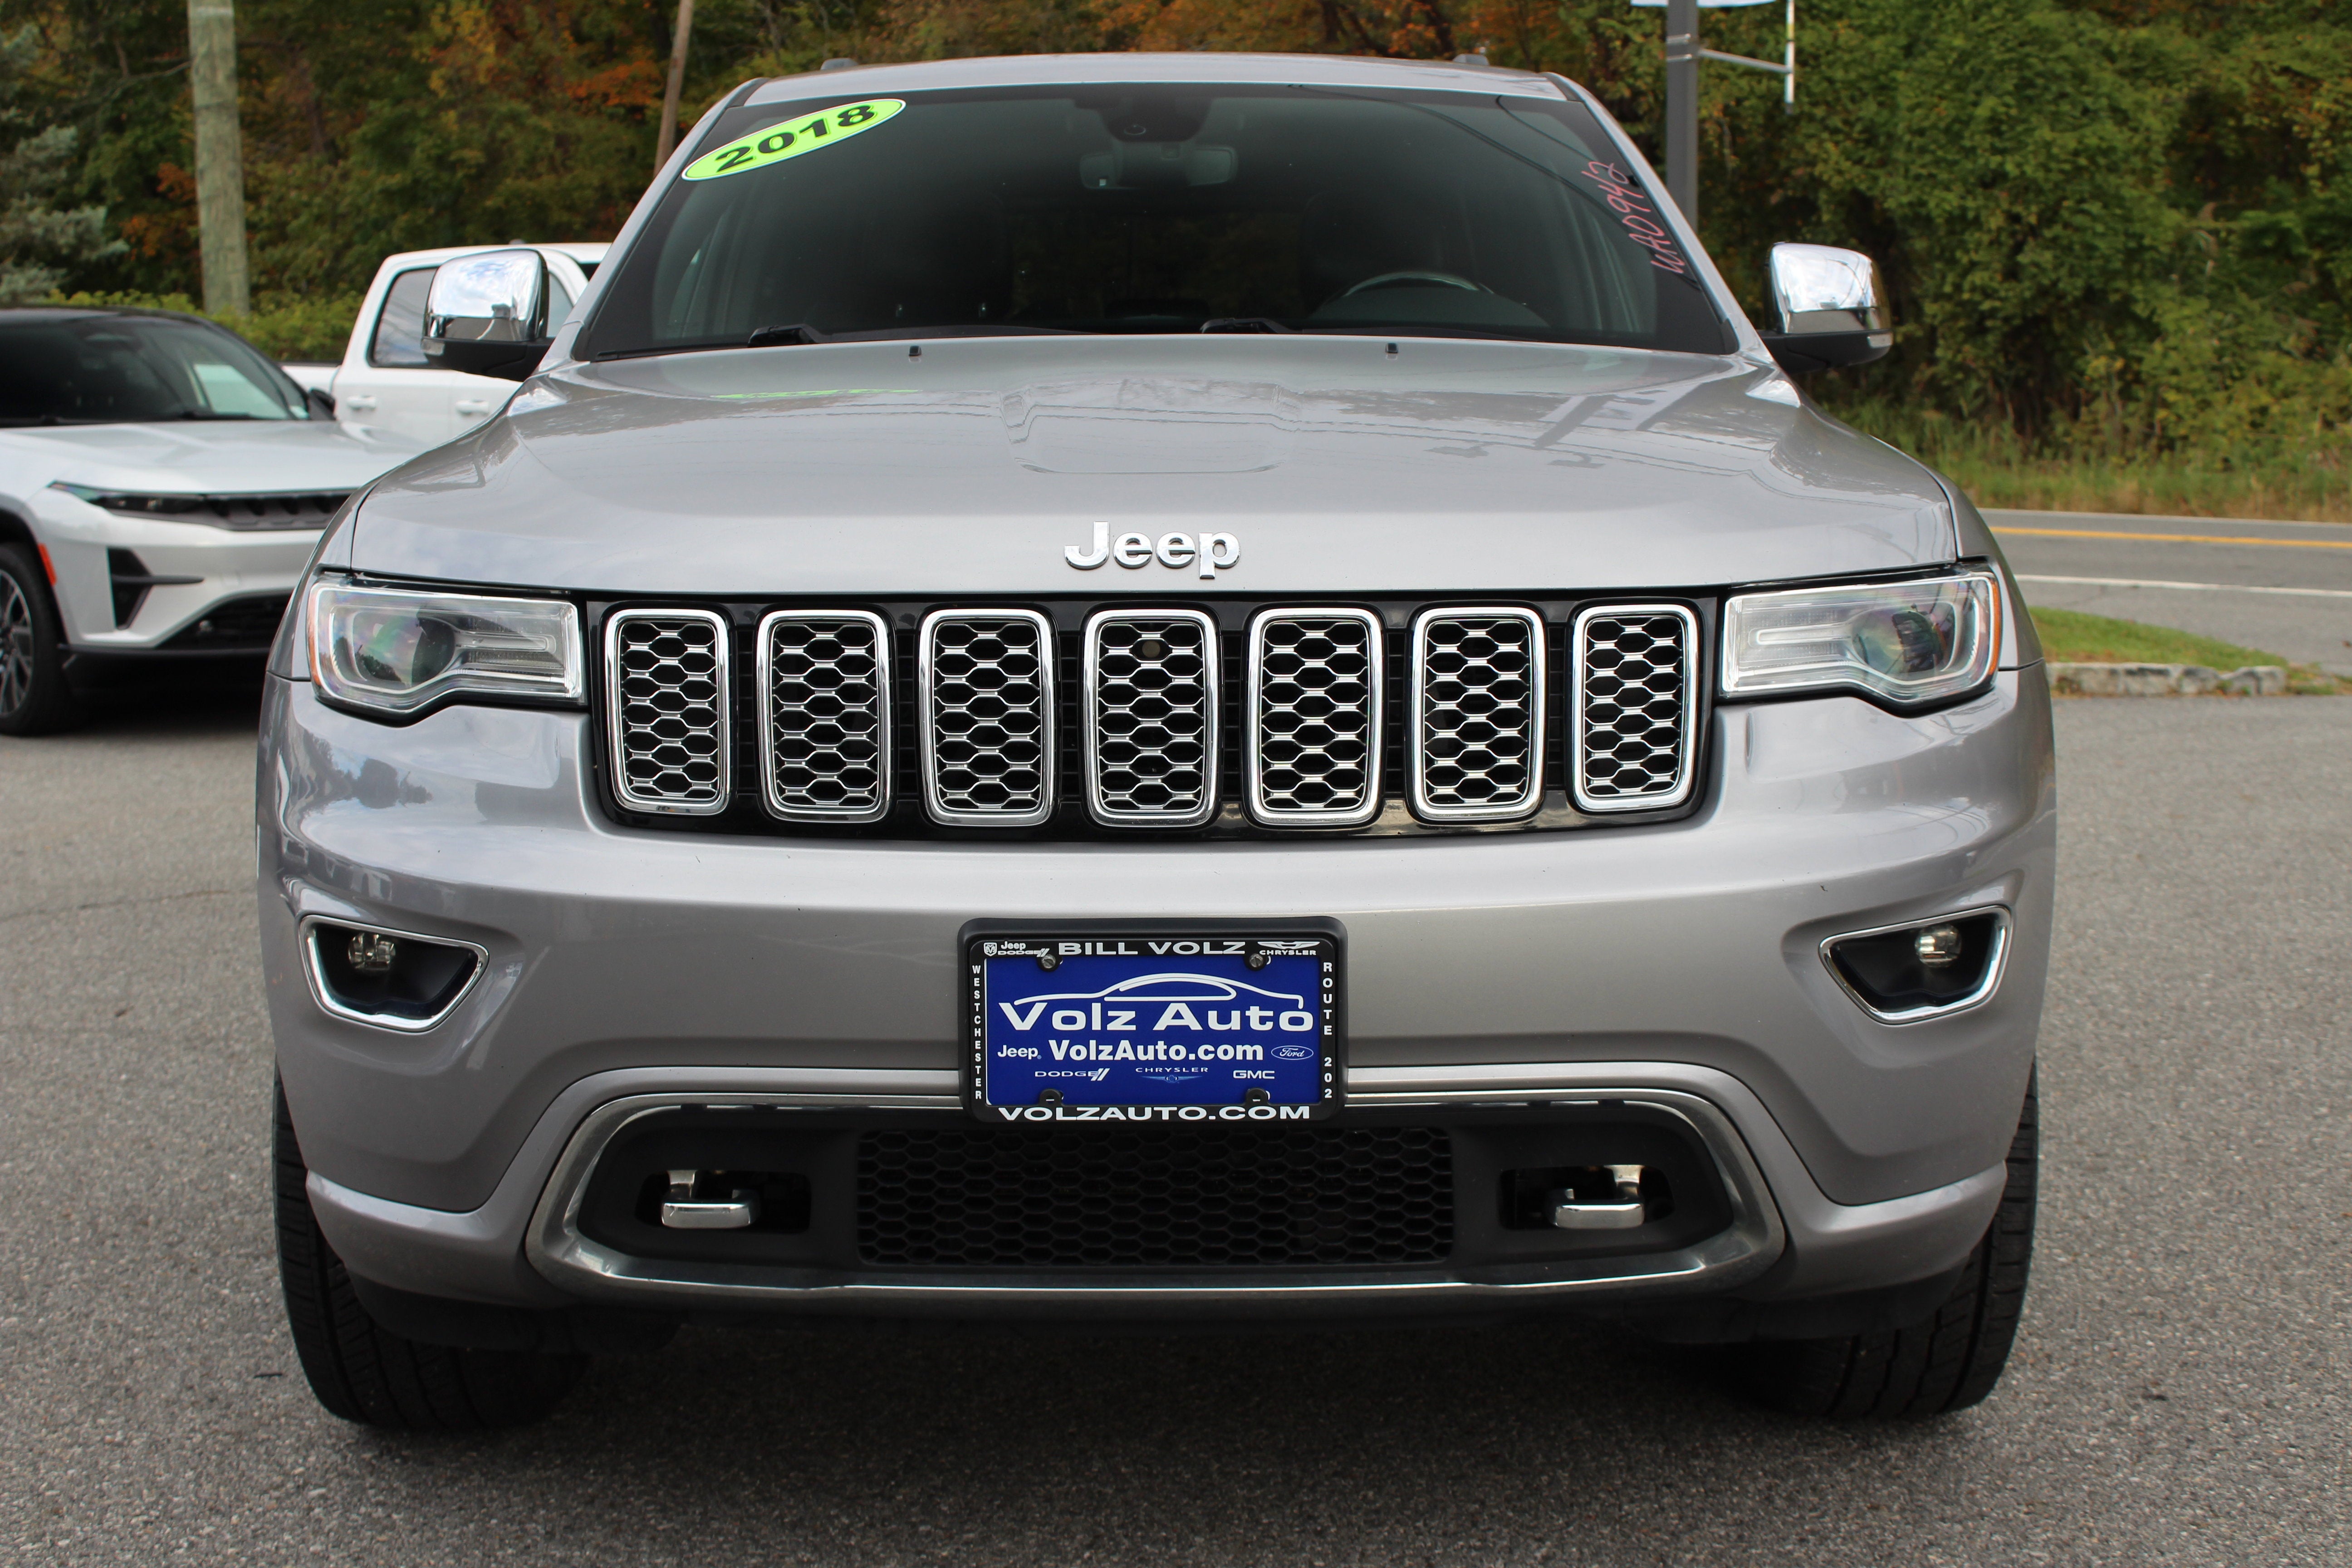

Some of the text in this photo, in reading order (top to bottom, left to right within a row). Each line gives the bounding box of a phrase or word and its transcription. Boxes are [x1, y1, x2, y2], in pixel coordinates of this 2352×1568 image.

[715, 105, 877, 173] 2018
[1064, 521, 1241, 579] Jeep
[1000, 941, 1026, 950] Jeep
[1058, 941, 1245, 955] BILL VOLZ
[999, 1002, 1314, 1031] Volz Auto
[972, 965, 981, 1099] WESTCHESTER
[1323, 962, 1333, 1098] ROUTE 202
[997, 1045, 1039, 1060] Jeep
[1048, 1039, 1264, 1061] VolzAuto.com
[1279, 1047, 1304, 1058] Ford
[1233, 1070, 1275, 1079] GMC
[998, 1106, 1310, 1121] VOLZAUTO.COM
